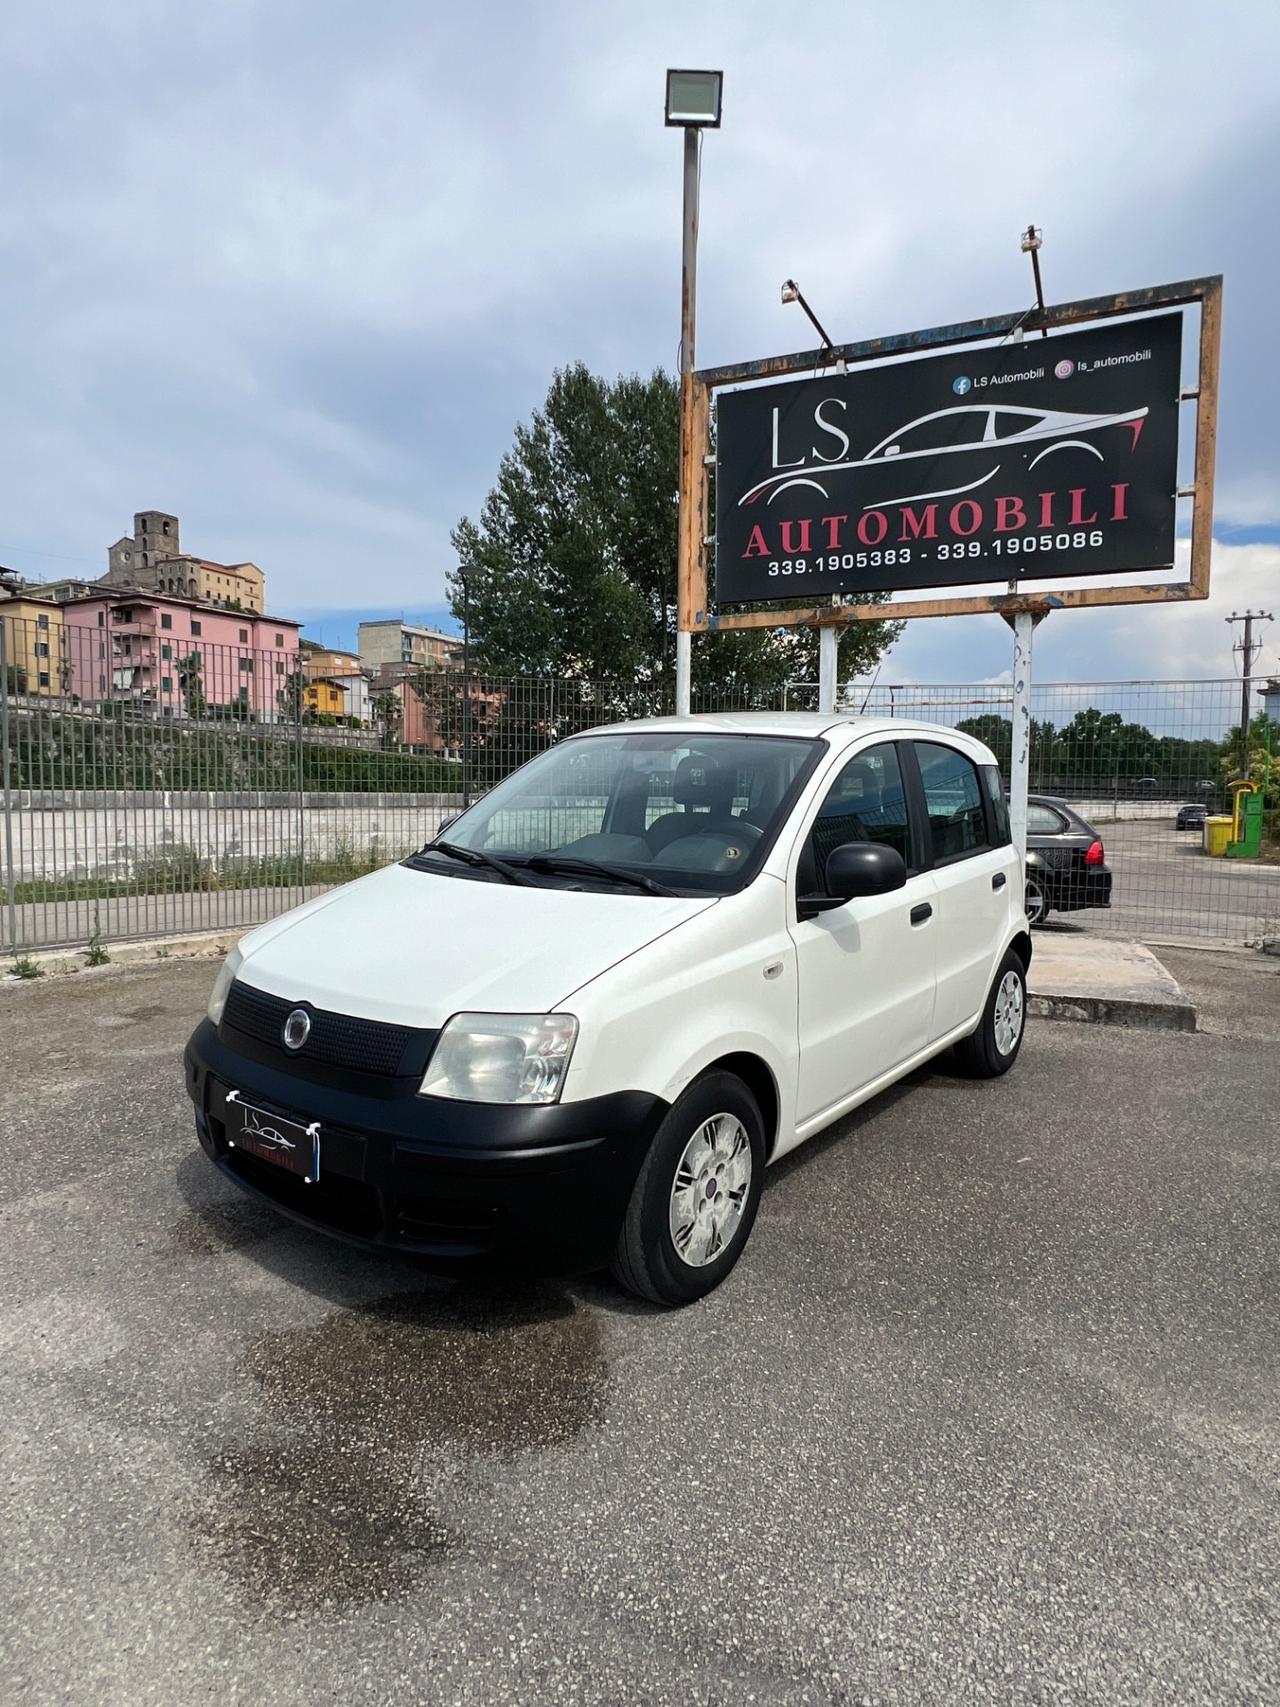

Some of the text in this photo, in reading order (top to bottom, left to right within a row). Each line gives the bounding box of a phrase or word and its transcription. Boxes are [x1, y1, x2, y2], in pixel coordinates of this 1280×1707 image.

[973, 376, 988, 388] LS
[989, 368, 1045, 385] Automobili
[1077, 350, 1152, 373] ls_automobili
[741, 482, 1130, 558] AUTOMOBILI
[768, 548, 911, 576] 339.1905383
[937, 530, 1104, 561] 339.1905086
